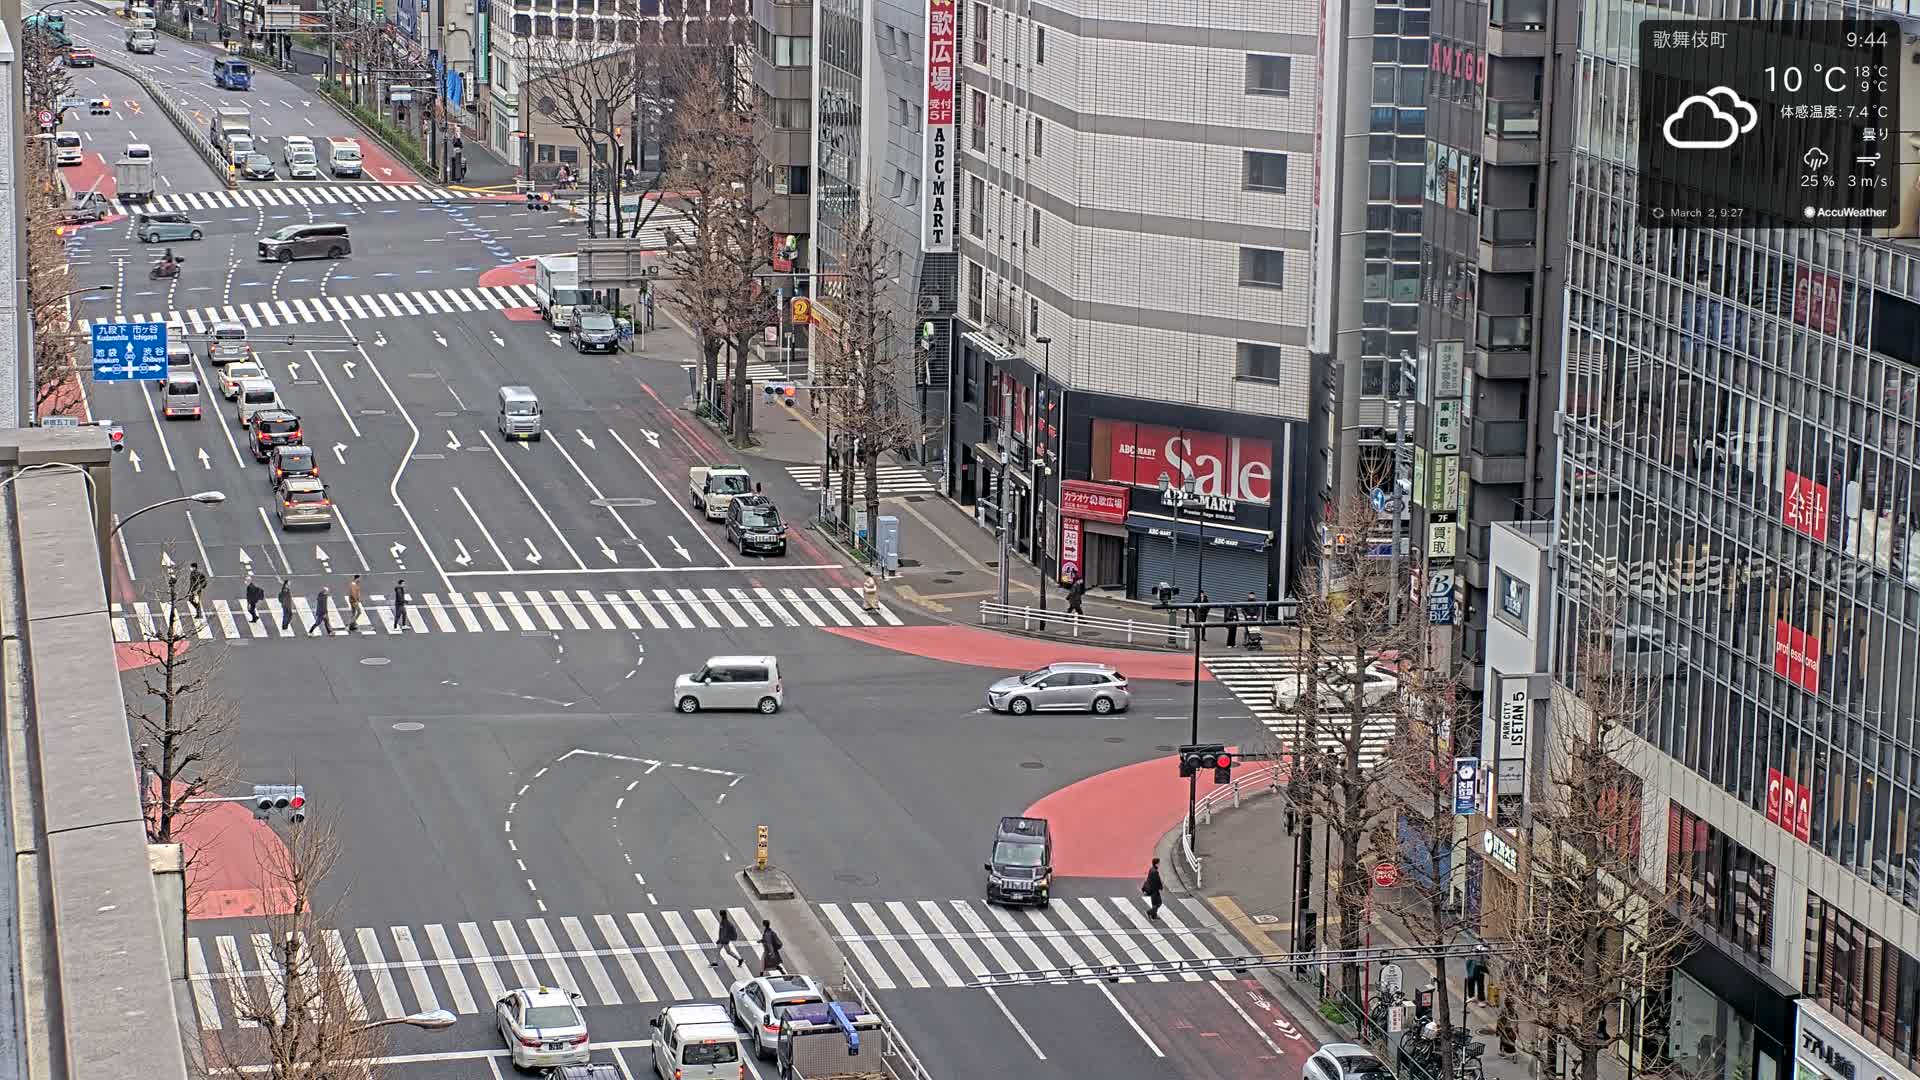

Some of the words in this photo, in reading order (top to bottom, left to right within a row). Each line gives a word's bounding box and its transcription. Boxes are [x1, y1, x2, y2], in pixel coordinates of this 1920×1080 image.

[931, 11, 953, 91] 歌広場
[1431, 42, 1486, 84] AMIGO
[929, 99, 952, 111] 受付
[929, 111, 952, 121] 5F
[98, 325, 127, 335] 九段下
[143, 347, 165, 356] 渋谷
[1119, 443, 1157, 456] ABCMART
[1163, 435, 1272, 506] Sale
[1063, 491, 1090, 503] カラオケ
[1788, 482, 1824, 532] 会計
[1437, 514, 1449, 522] 7F
[1433, 526, 1446, 553] 買取
[1513, 691, 1525, 701] 5
[1503, 702, 1511, 719] CITY
[1502, 721, 1510, 740] PARK
[1511, 705, 1525, 746] ISETAN
[1769, 779, 1809, 829] CPA
